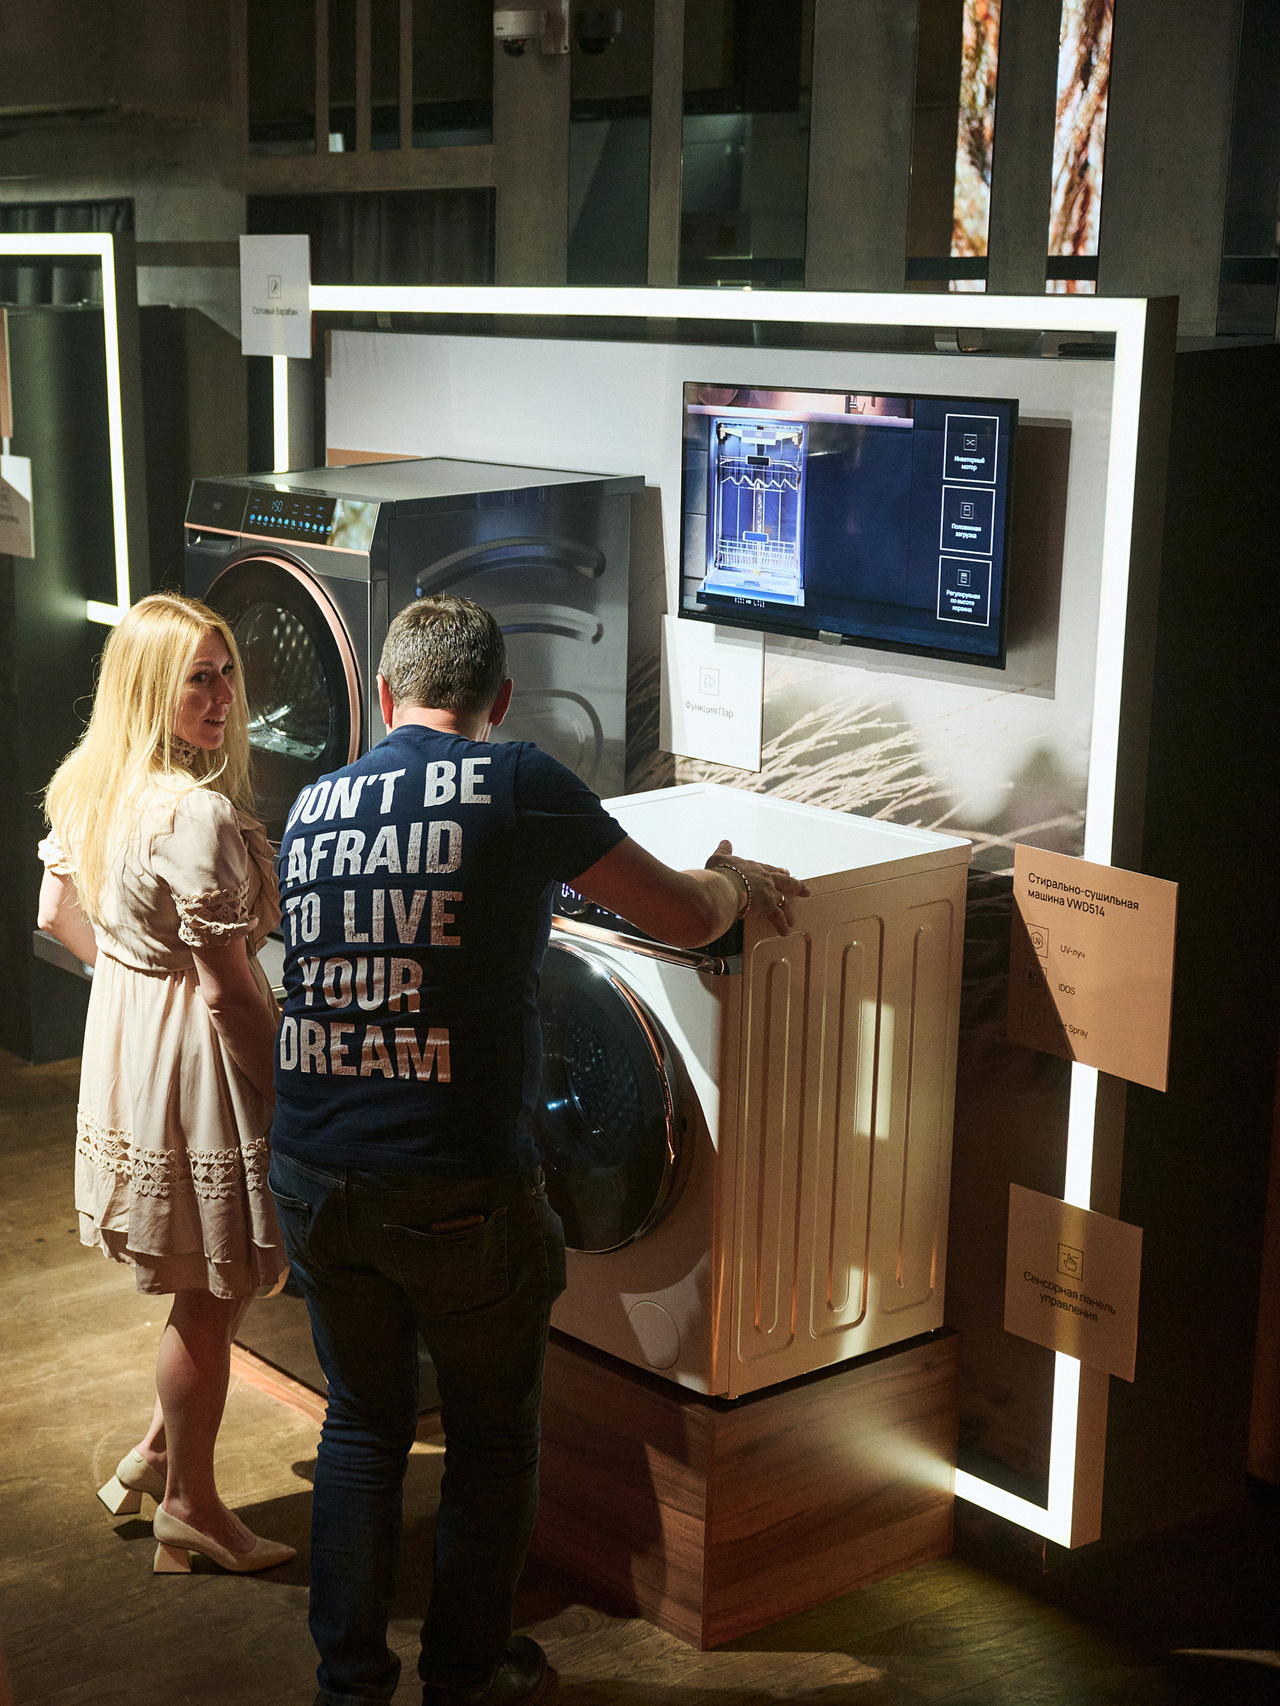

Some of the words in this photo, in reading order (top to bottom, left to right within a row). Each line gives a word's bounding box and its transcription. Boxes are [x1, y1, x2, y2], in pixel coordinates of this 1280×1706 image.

[955, 531, 977, 539] загрузка
[946, 589, 981, 599] Регулируемая
[685, 701, 717, 714] Функция
[719, 707, 733, 720] Пар
[285, 768, 406, 834] DON'T
[423, 757, 491, 807] BE
[286, 820, 463, 888] AFRAID
[1028, 872, 1139, 910] Стирально-сушильная
[1028, 889, 1065, 906] машина
[1067, 897, 1105, 917] VWD514
[285, 892, 320, 946] TO
[343, 889, 463, 946] LIVE
[1060, 944, 1085, 959] UV-луч
[297, 957, 423, 1012] YOUR
[1058, 983, 1076, 995] IDOS
[1068, 1024, 1089, 1039] Spray
[280, 1016, 451, 1083] DREAM
[1023, 1271, 1078, 1299] Сенсорная
[1080, 1294, 1116, 1315] панель
[1039, 1292, 1099, 1322] управления
